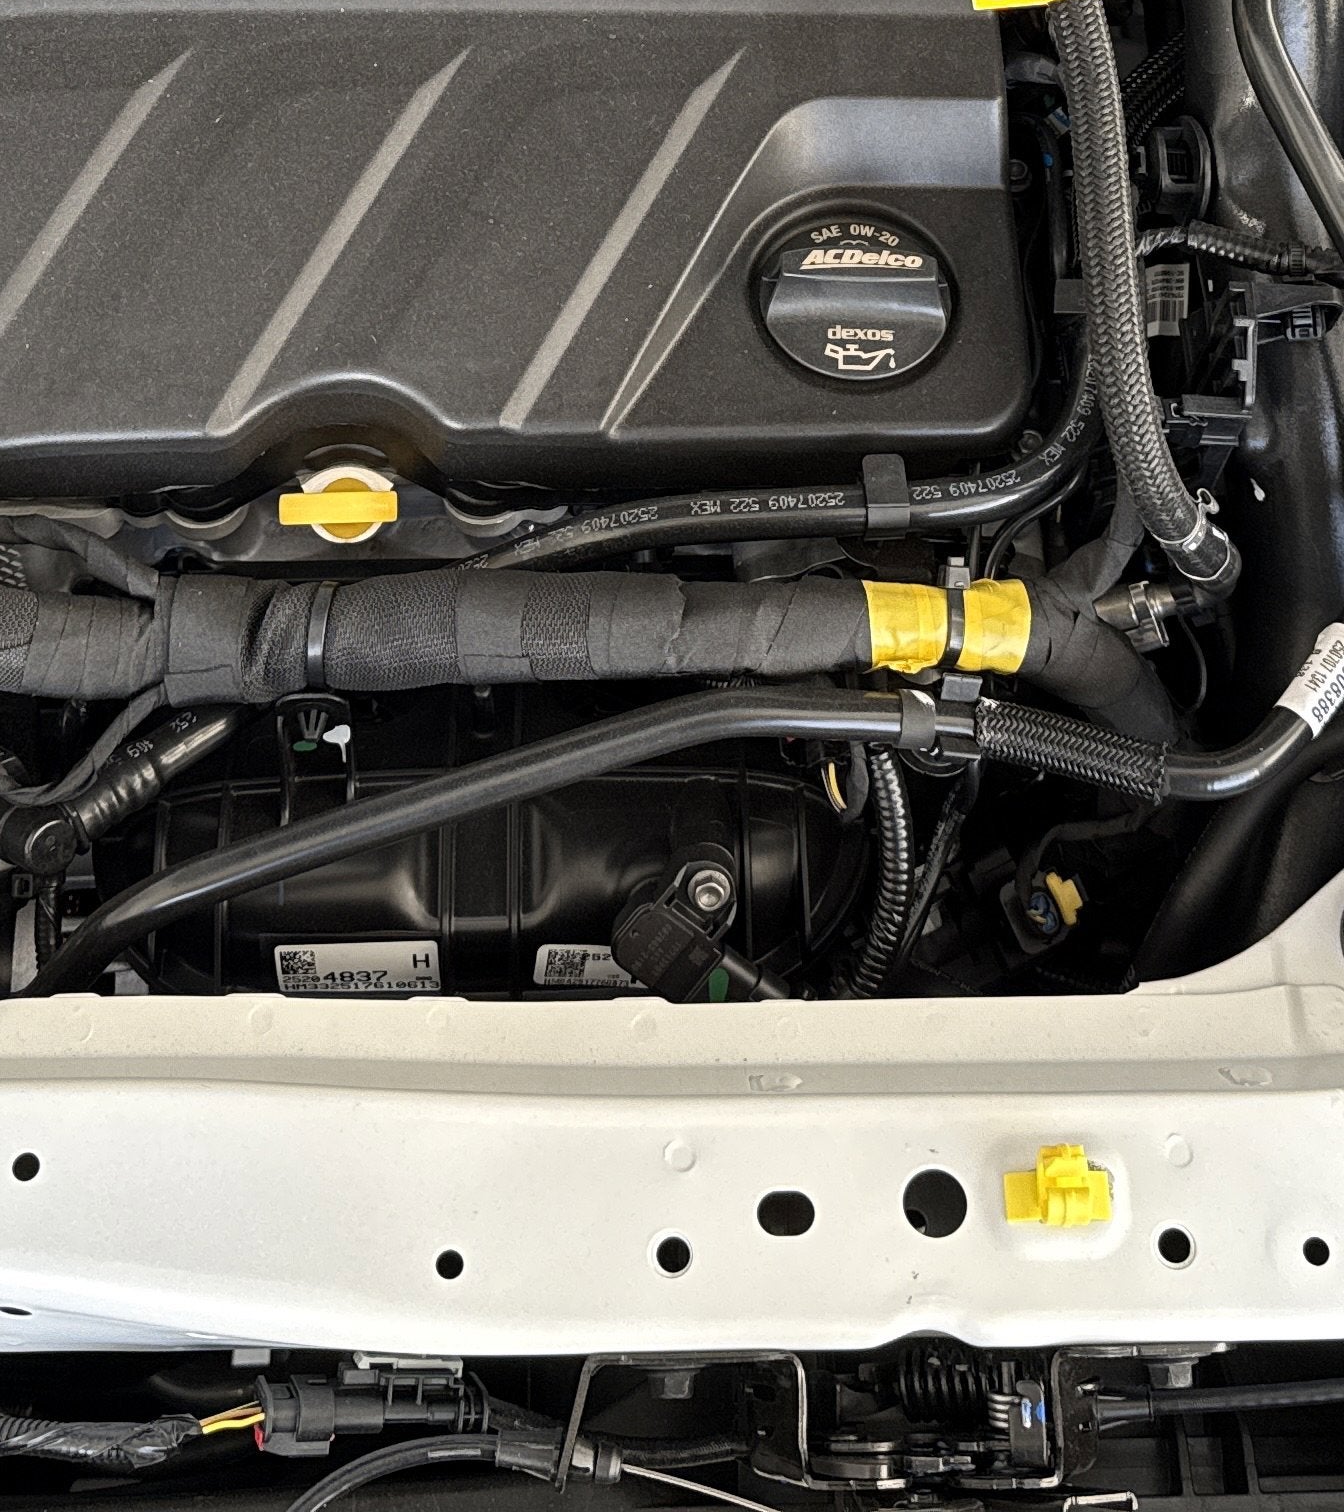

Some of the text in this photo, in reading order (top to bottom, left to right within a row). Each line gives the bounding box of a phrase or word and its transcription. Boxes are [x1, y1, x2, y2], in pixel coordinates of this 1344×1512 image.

[811, 225, 843, 243] SAE
[801, 249, 924, 269] ACDelco
[827, 325, 895, 341] dexos
[690, 499, 721, 516] MEX
[729, 496, 759, 513] 522
[412, 953, 430, 968] H
